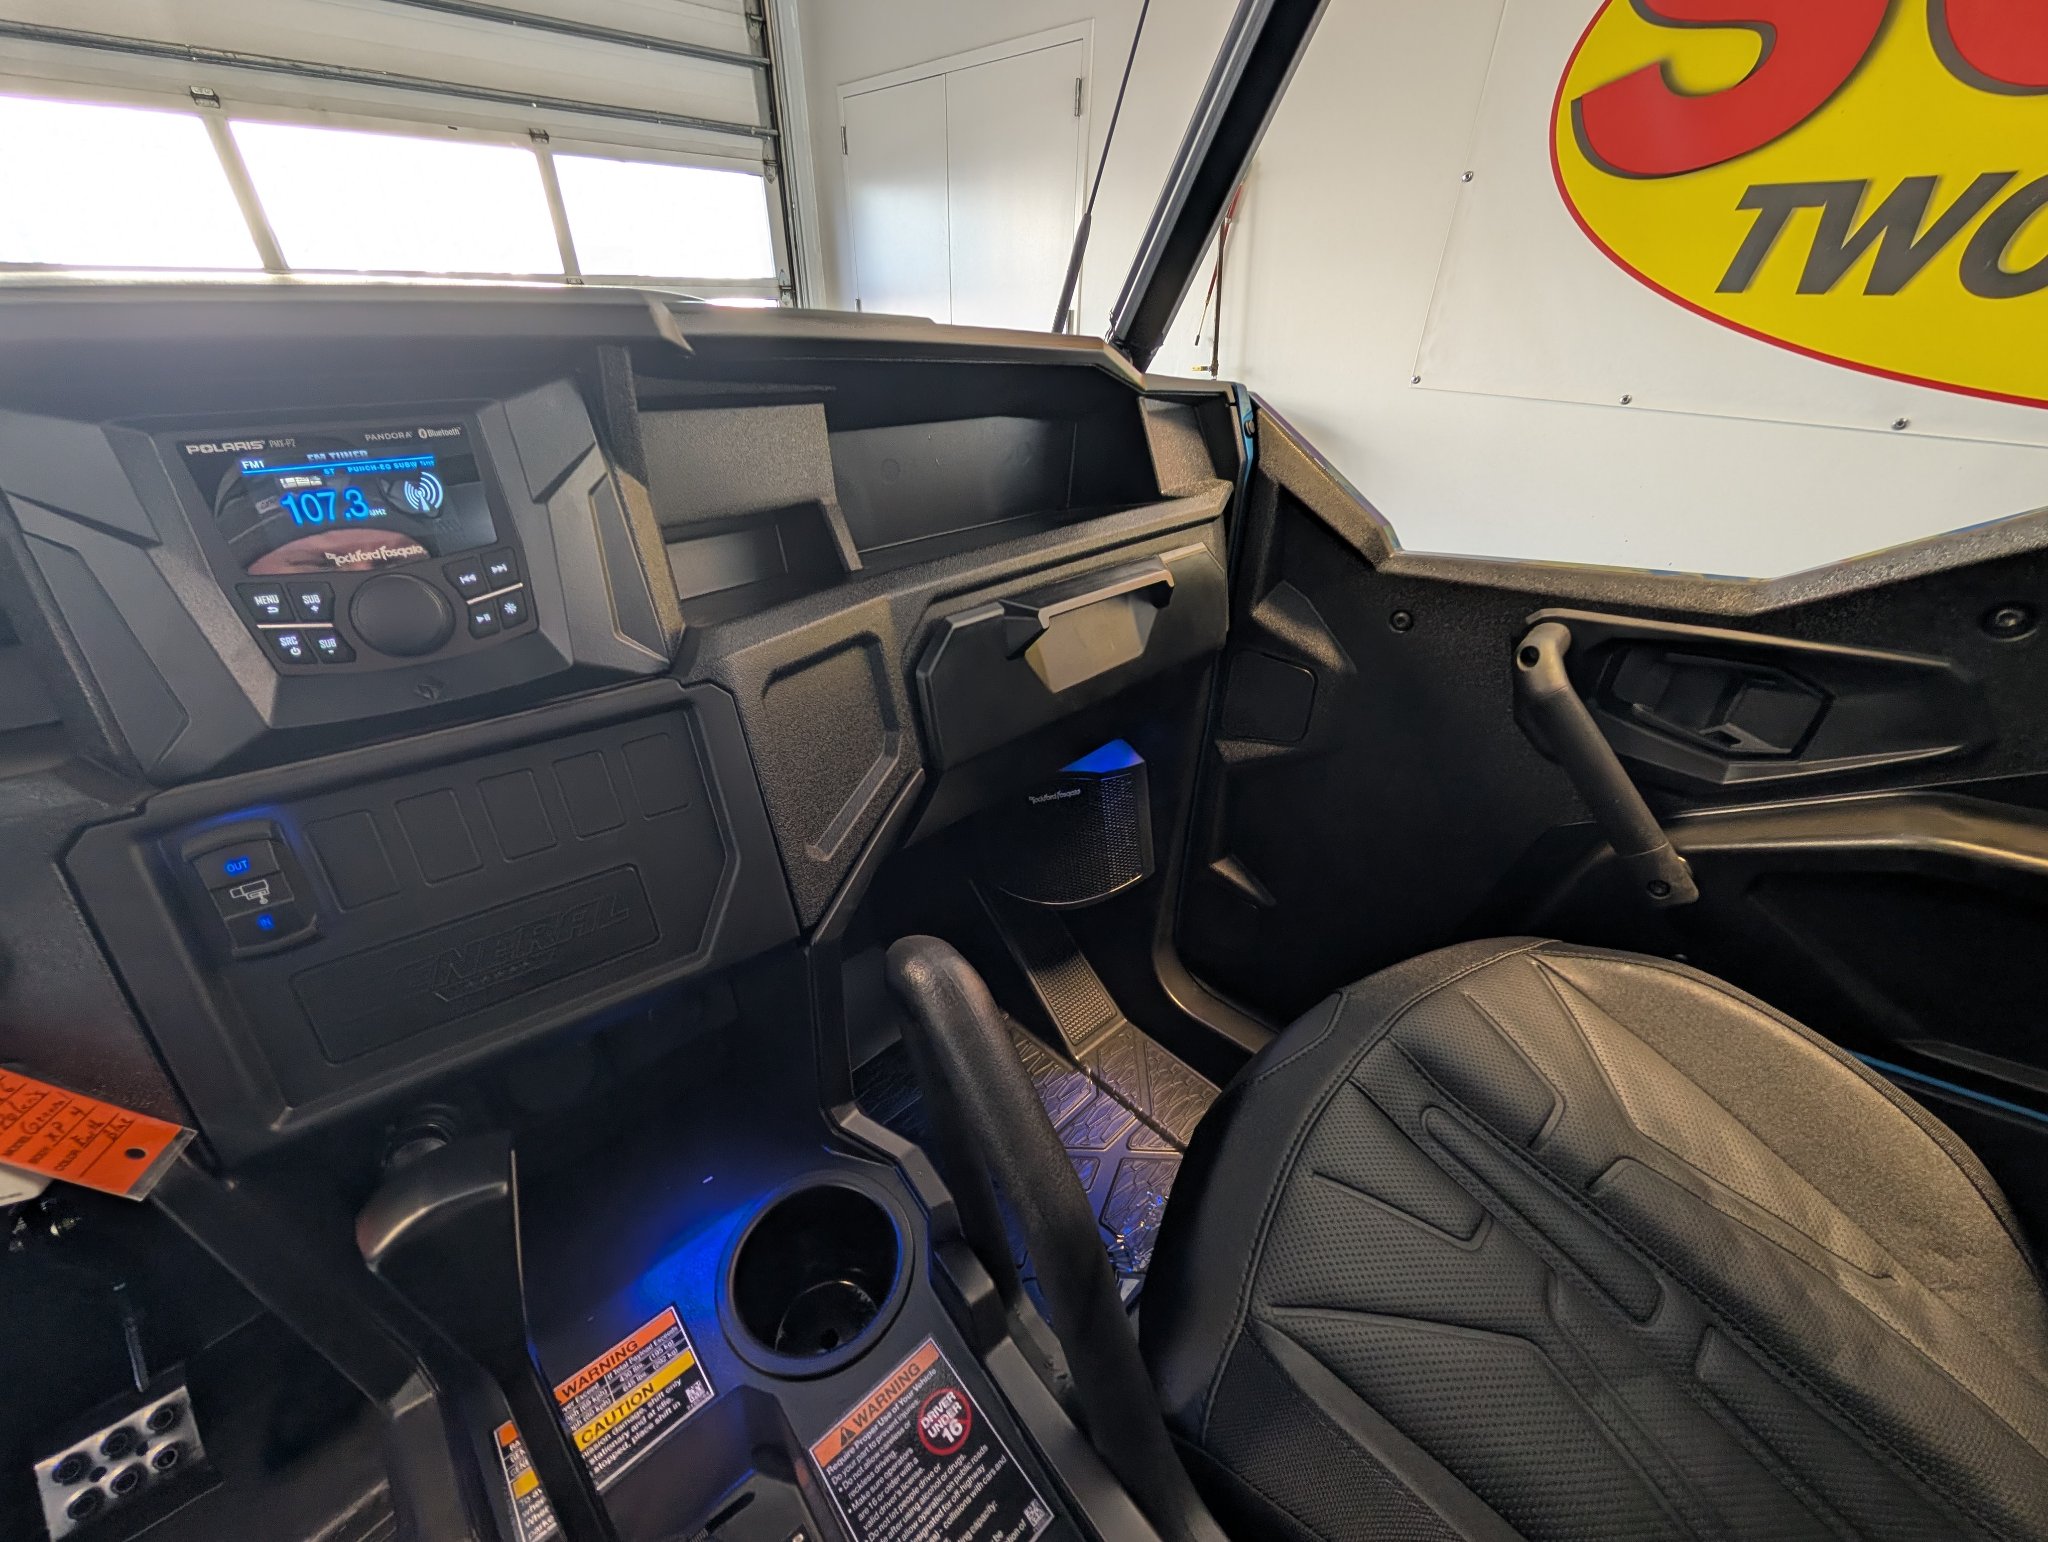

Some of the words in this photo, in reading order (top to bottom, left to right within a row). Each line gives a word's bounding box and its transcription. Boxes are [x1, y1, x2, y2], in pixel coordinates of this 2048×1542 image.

[185, 440, 265, 454] POLARIS
[364, 431, 411, 441] PANDORA
[426, 427, 460, 437] Bluetooth
[241, 459, 264, 469] FM1
[281, 489, 369, 526] 107.3
[324, 549, 380, 567] Rockford
[254, 592, 279, 607] MENU
[302, 593, 320, 605] SUB
[279, 634, 298, 648] SRC
[318, 637, 337, 650] SUB
[226, 859, 248, 872] OUT
[561, 1338, 639, 1400] WARNING
[646, 1390, 664, 1408] shift
[664, 1377, 682, 1395] only
[851, 1361, 921, 1430] WARNING
[919, 1390, 956, 1430] DRIVER
[579, 1382, 654, 1445] CAUTION
[629, 1414, 647, 1433] and
[630, 1420, 655, 1445] place
[653, 1406, 672, 1424] shift
[672, 1400, 681, 1410] in
[825, 1444, 856, 1477] Require
[853, 1422, 879, 1450] Proper
[877, 1409, 893, 1427] Use
[890, 1402, 900, 1414] of
[897, 1390, 913, 1408] Your
[912, 1367, 937, 1393] Vehicle
[926, 1400, 963, 1440] UNDER
[940, 1416, 965, 1446] 16
[831, 1471, 843, 1485] Do
[841, 1458, 857, 1477] your
[855, 1446, 870, 1463] part
[868, 1439, 877, 1449] to
[874, 1417, 899, 1444] prevent
[841, 1475, 853, 1490] Do
[851, 1465, 864, 1480] not
[862, 1448, 880, 1470] allow
[878, 1425, 905, 1454] careless
[903, 1419, 911, 1430] or
[846, 1469, 874, 1499] reckless
[850, 1487, 871, 1511] Make
[869, 1475, 884, 1493] sure
[882, 1446, 914, 1480] operators
[857, 1506, 869, 1521] are
[868, 1496, 878, 1510] 16
[876, 1490, 885, 1502] or
[882, 1472, 901, 1494] older
[898, 1459, 914, 1478] with
[900, 1518, 919, 1542] allow
[916, 1488, 948, 1525] operation
[952, 1460, 973, 1485] public
[969, 1442, 989, 1465] roads
[941, 1498, 952, 1513] for
[949, 1462, 986, 1505] off-highway
[941, 1493, 972, 1530] collisions
[968, 1479, 984, 1499] with
[981, 1467, 996, 1485] cars
[992, 1453, 1007, 1471] and
[862, 1511, 879, 1532] valid
[867, 1526, 880, 1542] Do
[877, 1515, 890, 1532] not
[888, 1506, 899, 1520] let
[897, 1485, 921, 1513] people
[917, 1468, 935, 1489] drive
[933, 1462, 941, 1474] or
[886, 1518, 903, 1539] after
[901, 1501, 921, 1525] using
[917, 1476, 941, 1505] alcohol
[968, 1499, 999, 1538] capacity:
